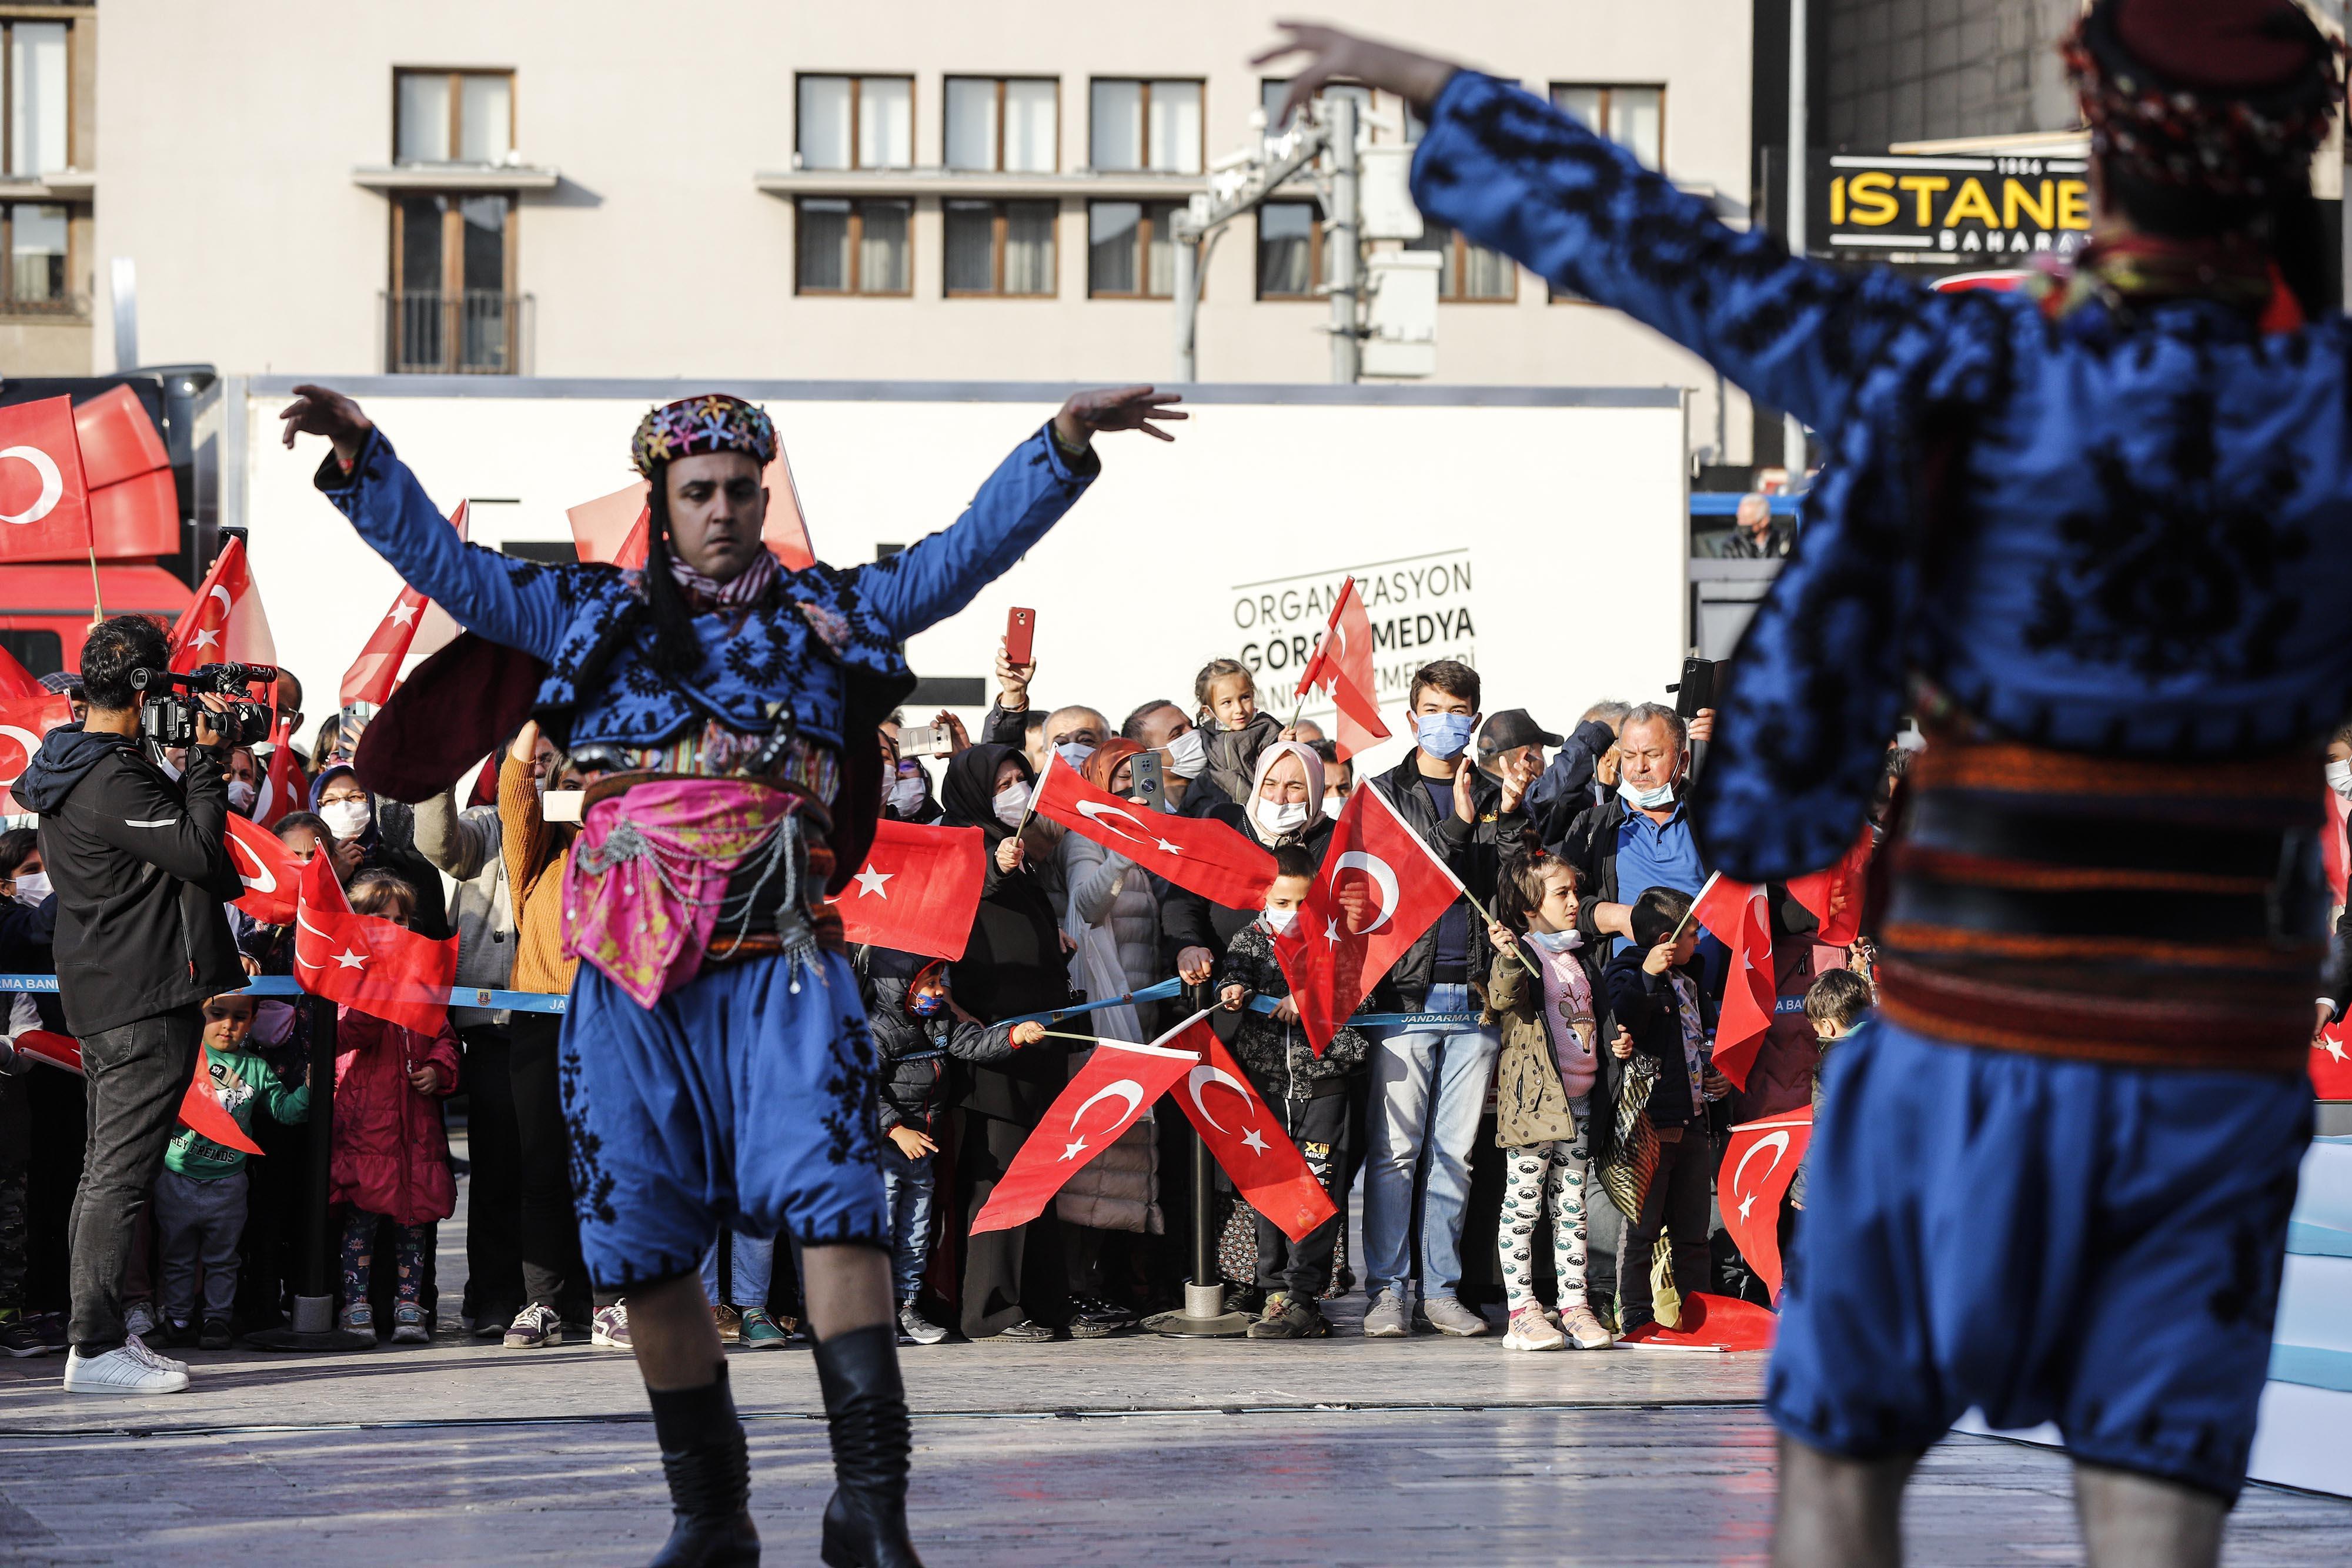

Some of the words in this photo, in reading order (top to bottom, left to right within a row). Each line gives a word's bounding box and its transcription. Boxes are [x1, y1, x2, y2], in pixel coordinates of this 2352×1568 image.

[1234, 561, 1472, 629] ORGANZASYON
[1371, 607, 1475, 654] MEDYA
[1401, 1014, 1470, 1023] JANDARMA
